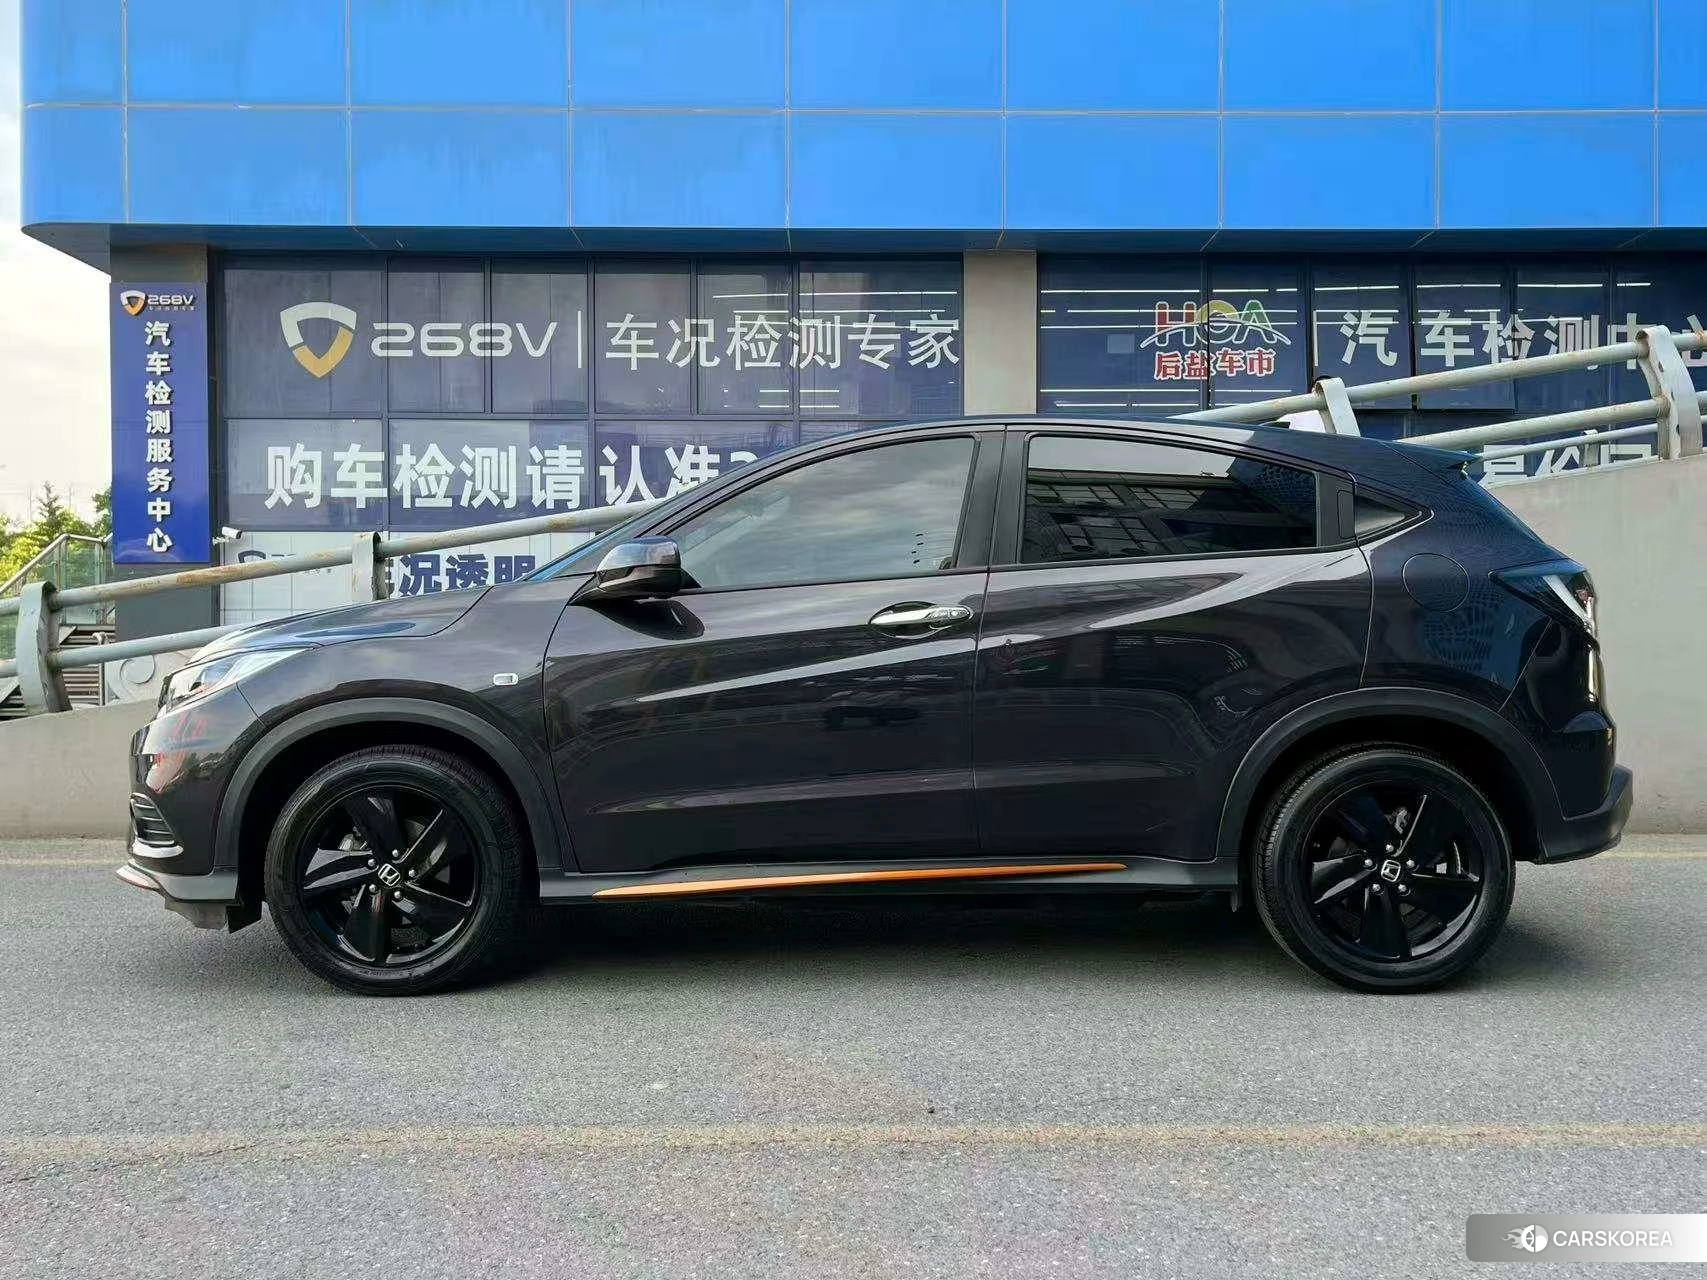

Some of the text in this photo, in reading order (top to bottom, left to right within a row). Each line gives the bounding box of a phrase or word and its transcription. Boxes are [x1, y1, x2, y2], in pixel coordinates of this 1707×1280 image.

[147, 294, 194, 306] 268V
[370, 321, 558, 358] 268V
[605, 312, 961, 371] 车况检测专家
[145, 320, 174, 554] 汽车检测服务中心
[264, 442, 760, 510] 购车检测请认准
[384, 553, 536, 598] 况透明
